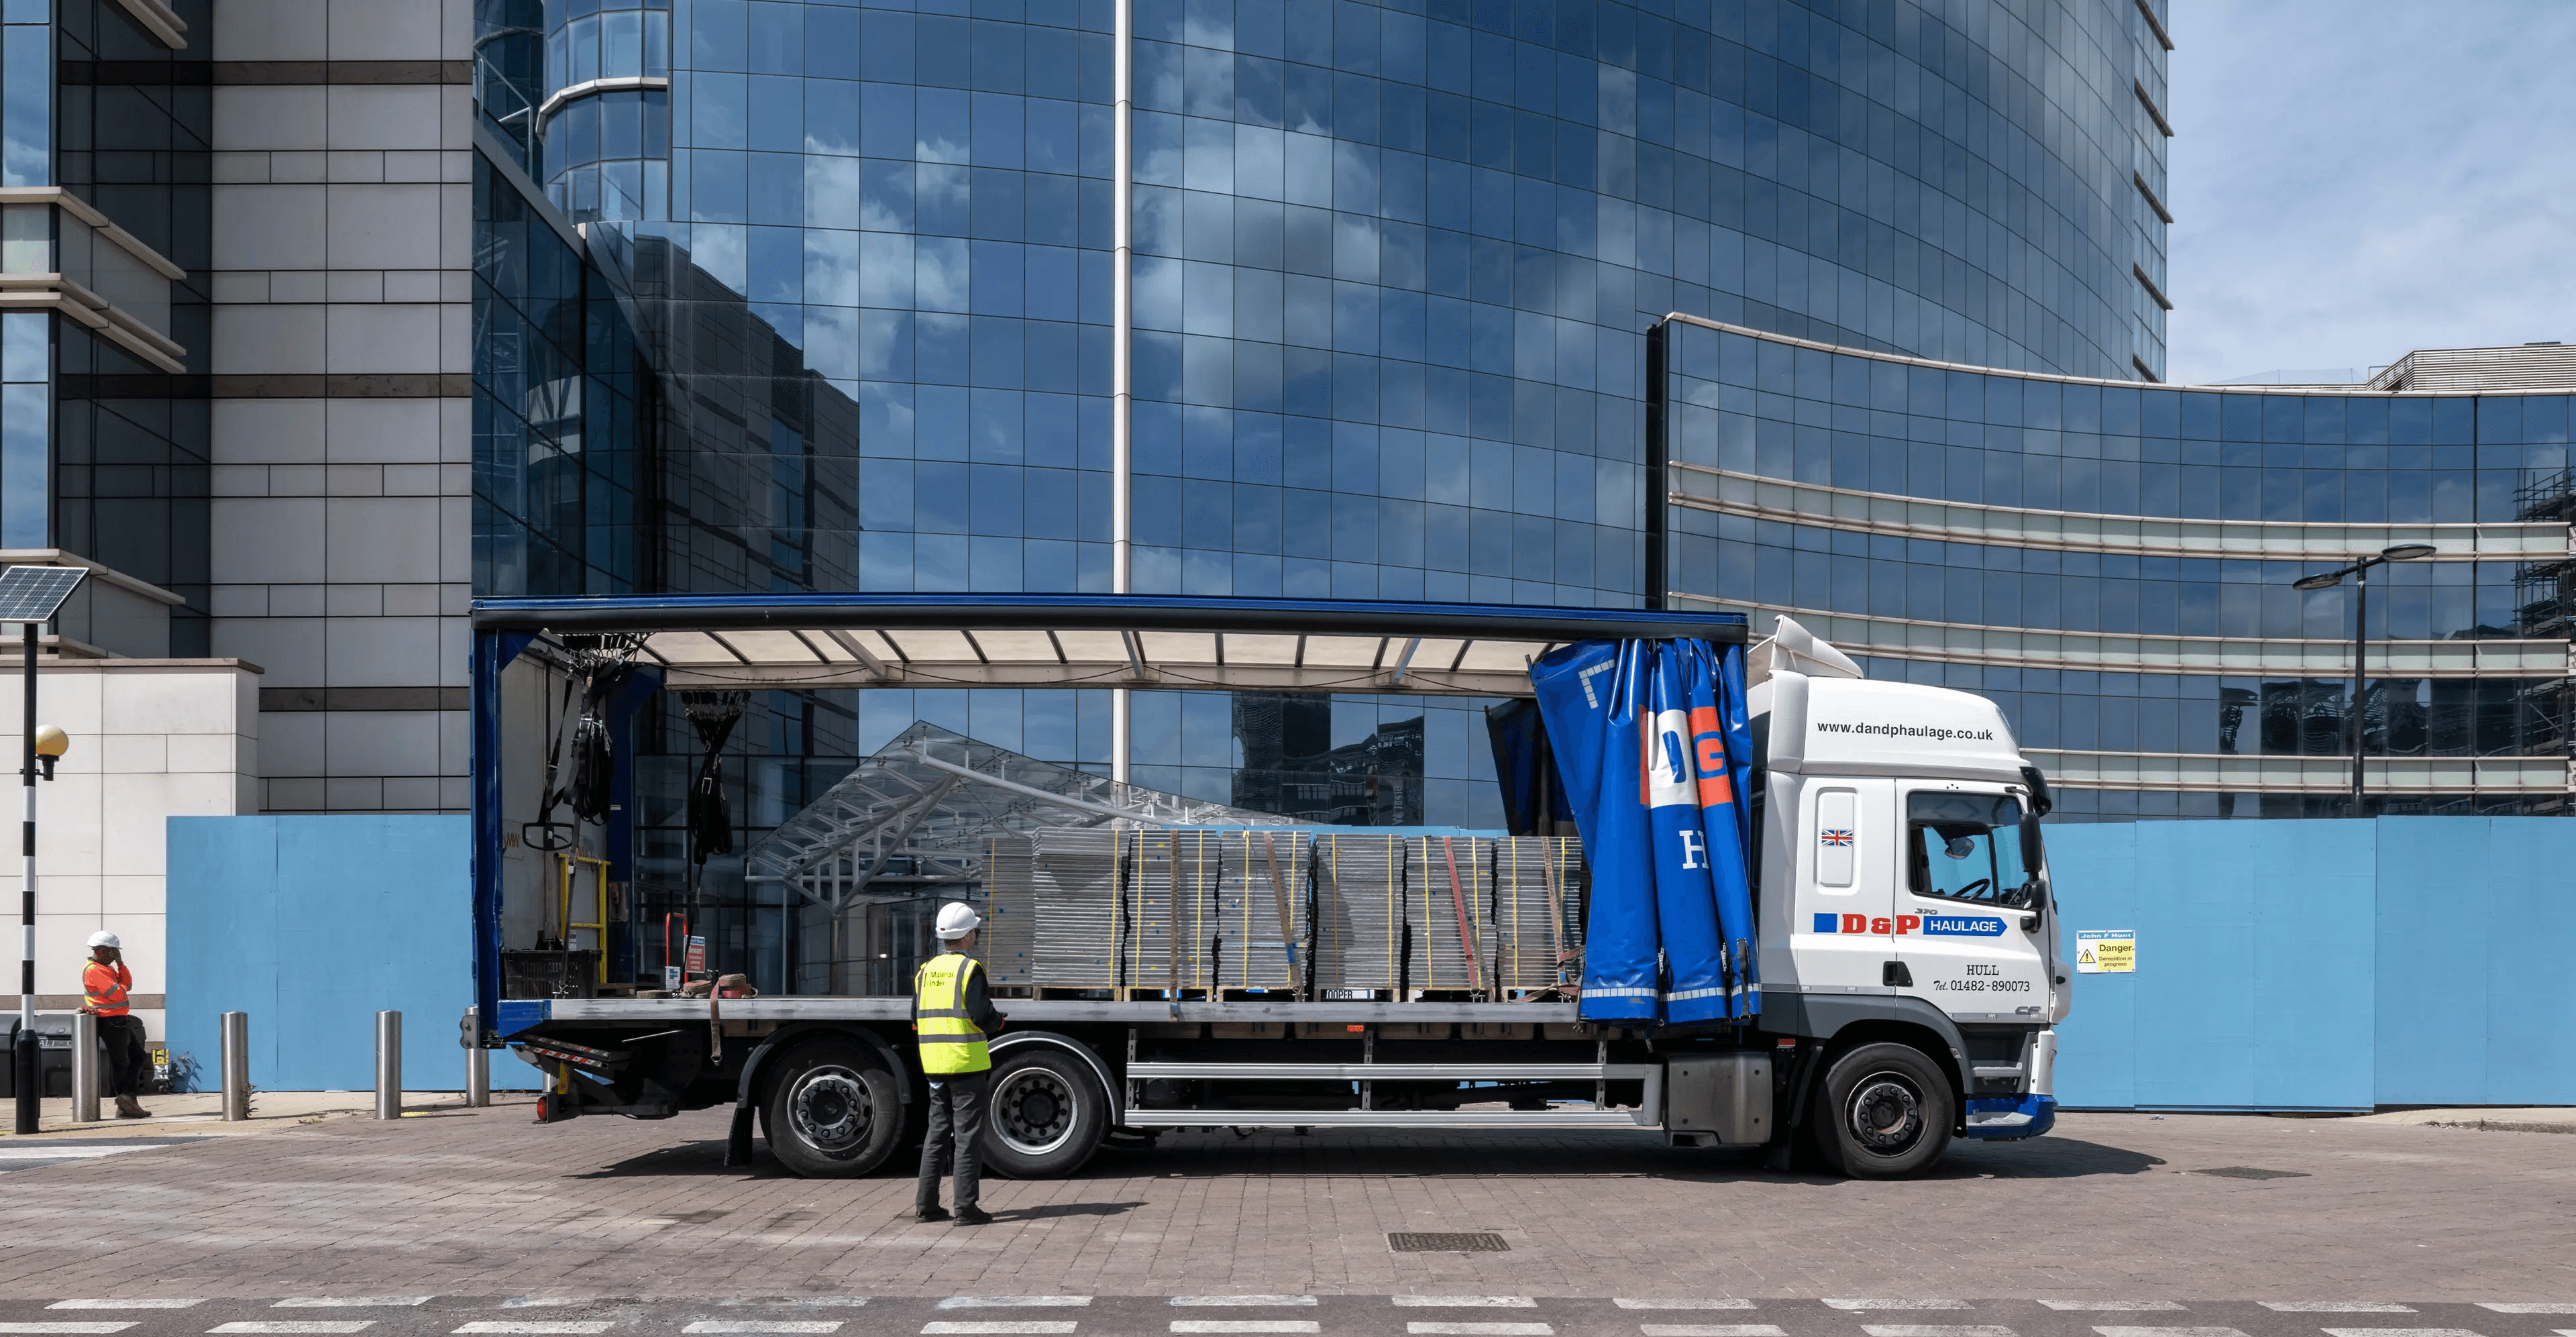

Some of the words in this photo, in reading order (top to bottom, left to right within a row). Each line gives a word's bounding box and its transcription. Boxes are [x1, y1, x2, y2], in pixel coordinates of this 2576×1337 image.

[1817, 723, 1993, 741] www.dandphaulage.co.uk
[1841, 913, 1921, 935] D&P
[1930, 920, 1998, 932] HAULAGE
[2100, 945, 2132, 953] Danger
[1966, 965, 2000, 975] HULL
[1933, 980, 1948, 992] Tel.
[1951, 980, 2030, 992] 01482-890073
